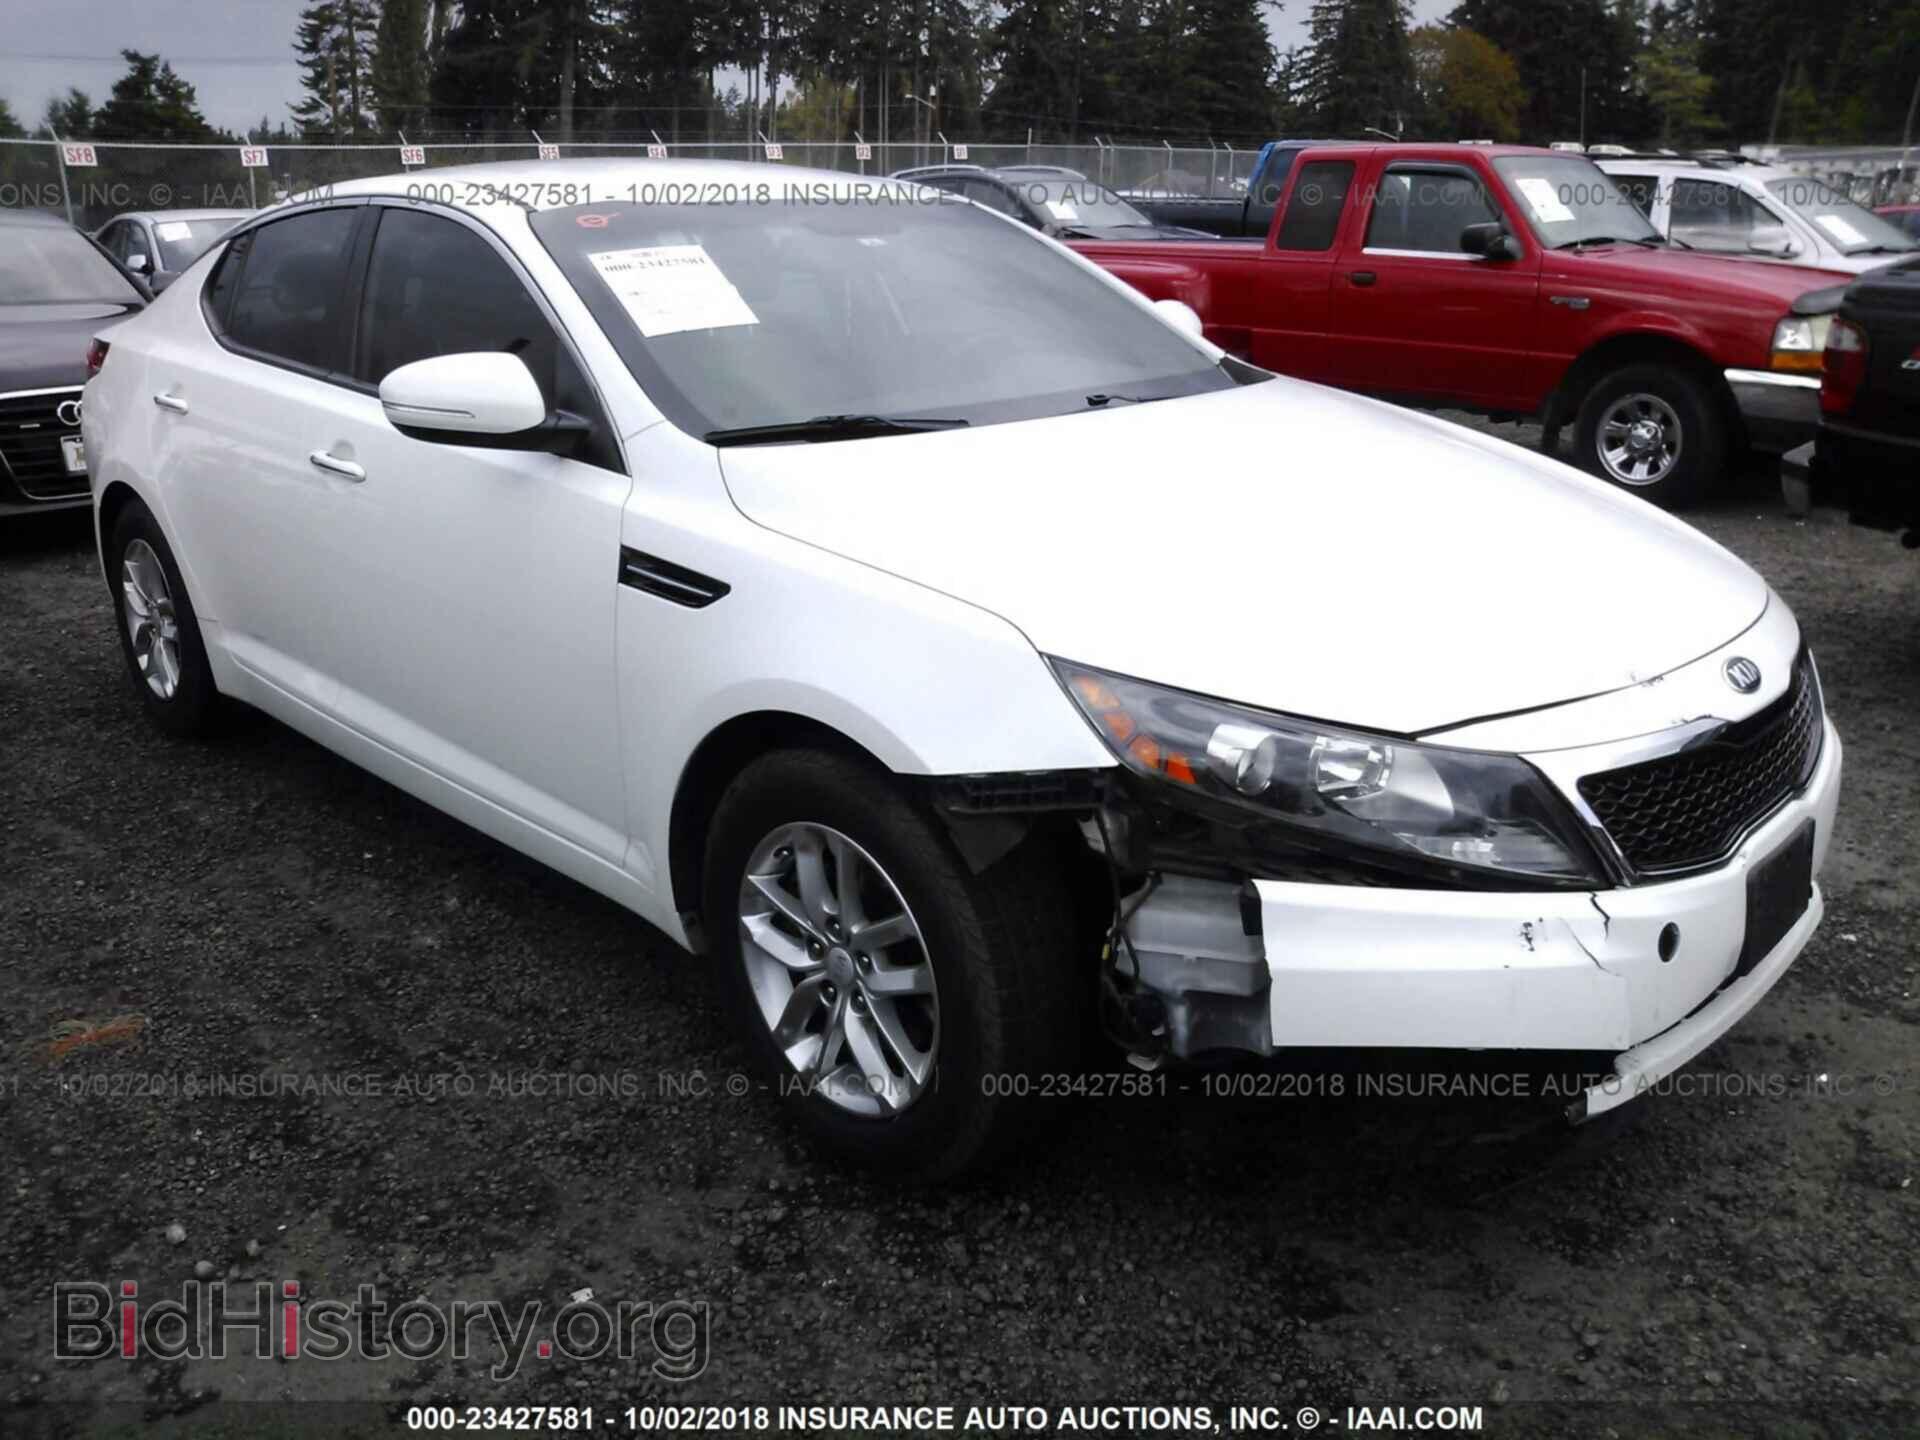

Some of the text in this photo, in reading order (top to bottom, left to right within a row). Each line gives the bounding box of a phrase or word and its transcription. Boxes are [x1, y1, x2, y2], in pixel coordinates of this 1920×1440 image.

[66, 146, 94, 164] SF8
[243, 149, 264, 164] SF7
[402, 148, 422, 162] SF6
[1728, 660, 1757, 688] KIA
